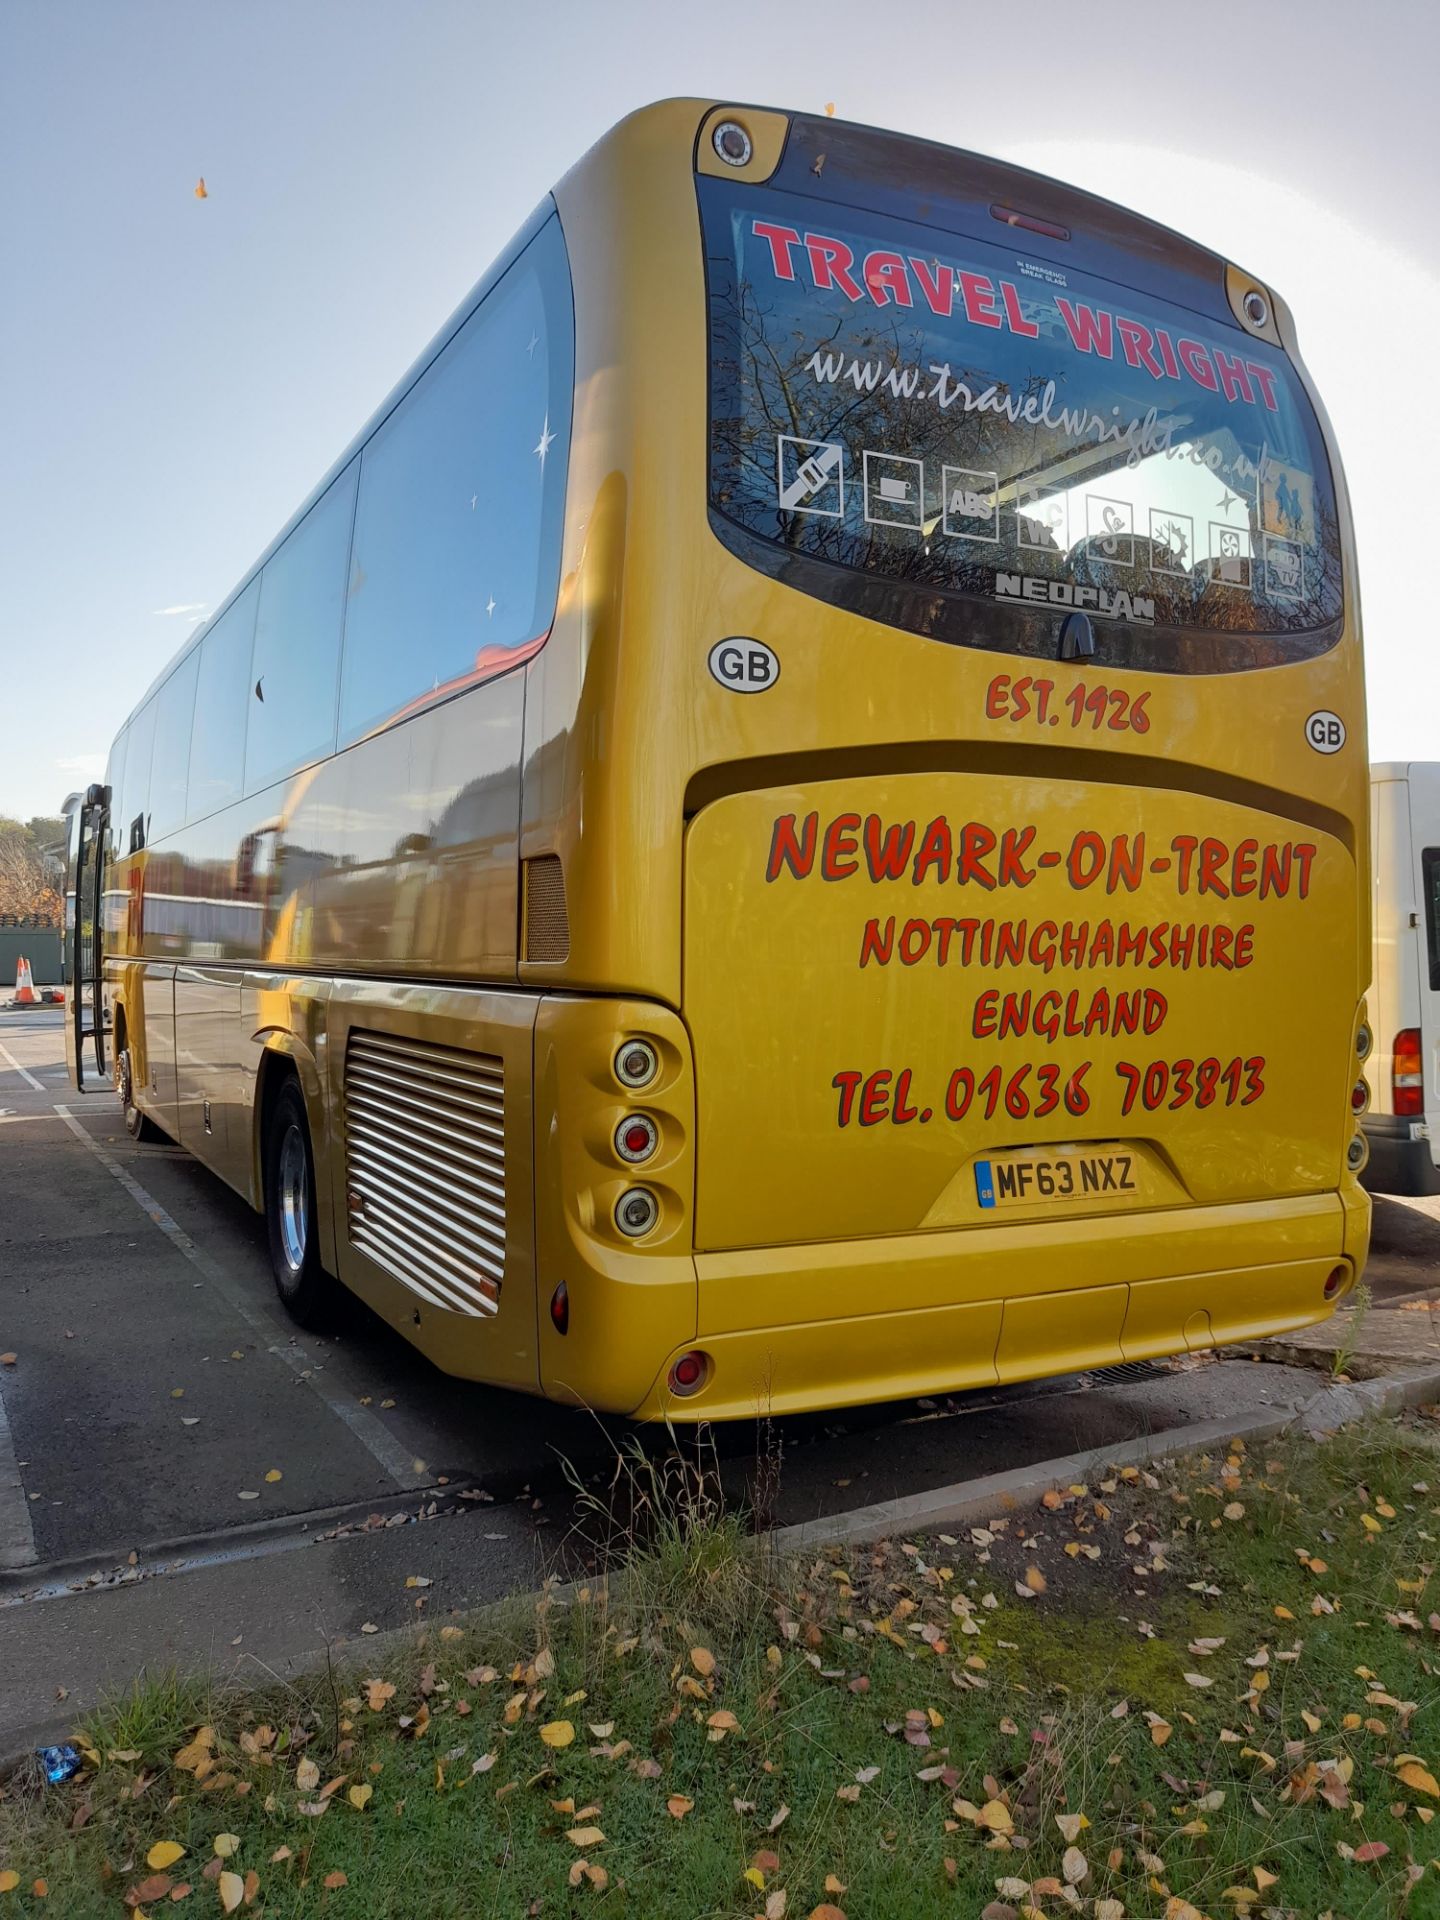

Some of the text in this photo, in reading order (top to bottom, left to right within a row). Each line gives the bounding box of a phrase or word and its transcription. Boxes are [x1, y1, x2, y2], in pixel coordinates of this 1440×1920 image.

[752, 220, 1279, 412] TRAVEL WRIGHT
[949, 489, 992, 520] ABS
[995, 572, 1155, 625] NEOPLAN
[718, 647, 771, 683] GB
[1310, 718, 1341, 746] GB
[766, 811, 1317, 901] NEWARK-ON-TRENT
[860, 916, 1255, 972] NOTTINGHAMSHIRE
[972, 988, 1168, 1043] ENGLAND
[1115, 1056, 1266, 1116] 703813
[981, 1189, 993, 1199] GB
[997, 1157, 1135, 1199] MF63 NXZ
